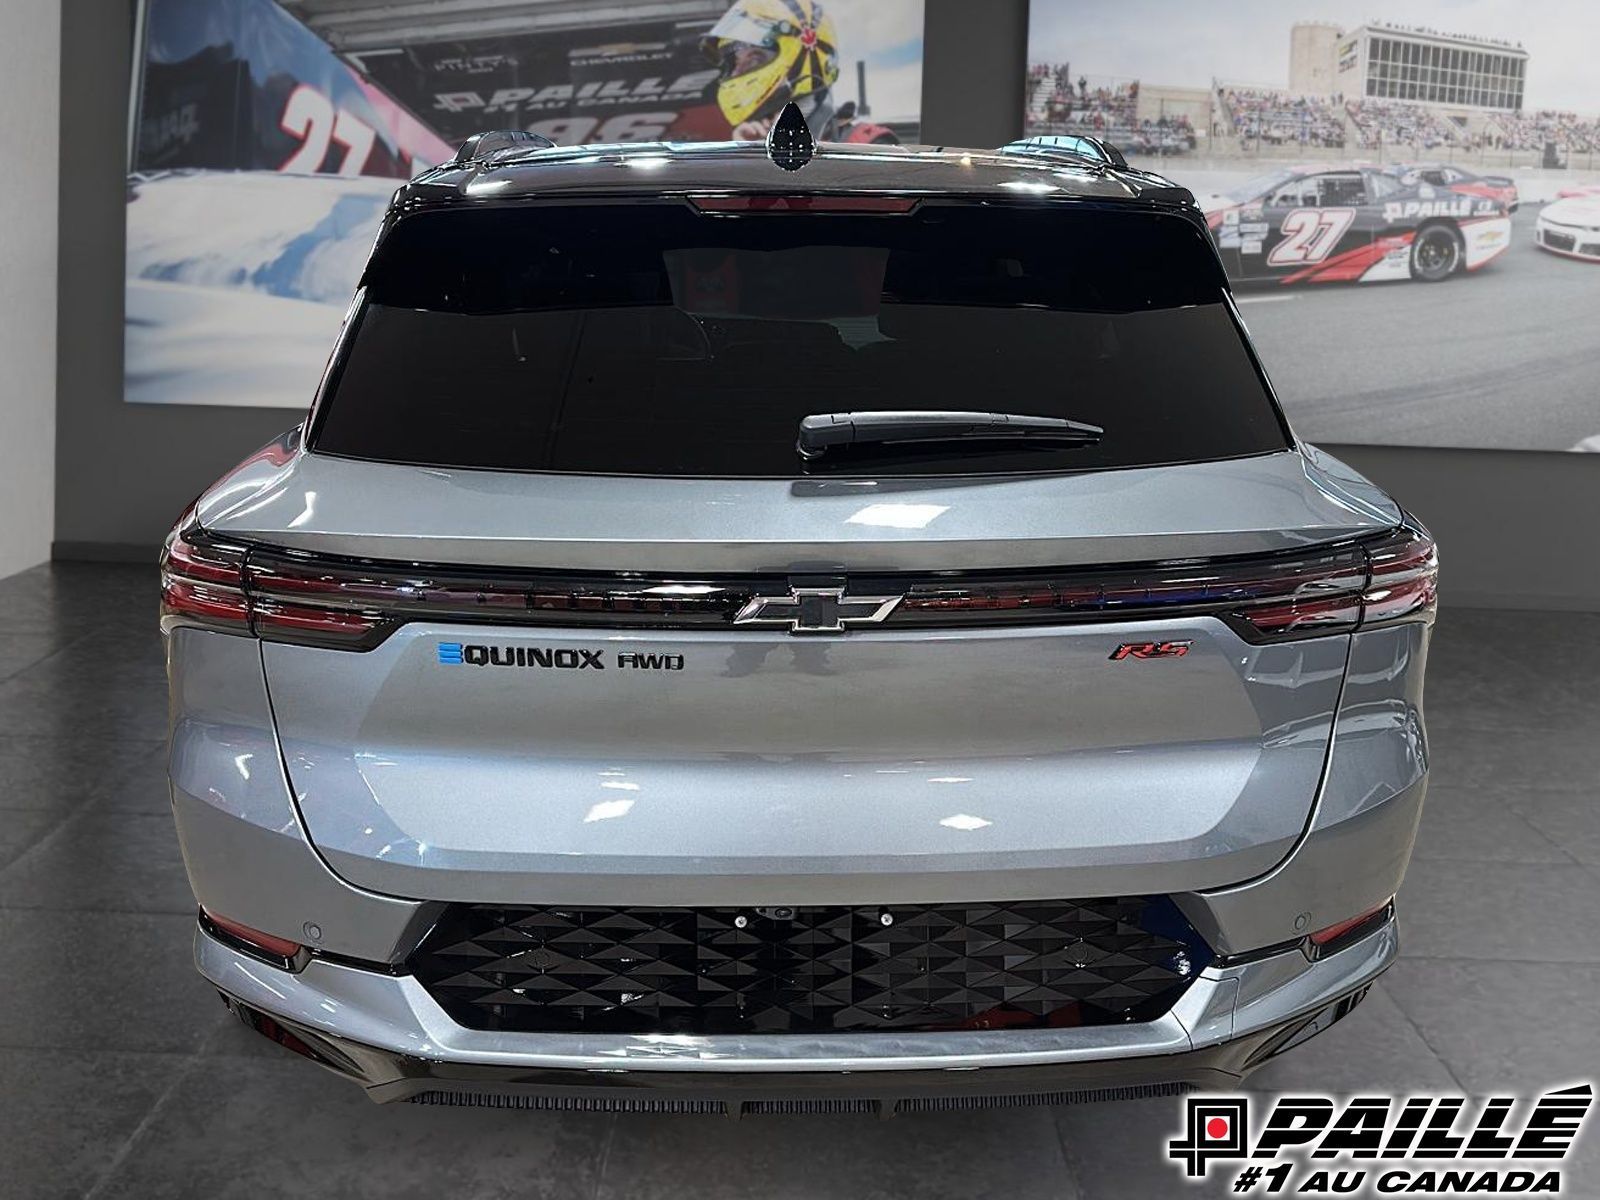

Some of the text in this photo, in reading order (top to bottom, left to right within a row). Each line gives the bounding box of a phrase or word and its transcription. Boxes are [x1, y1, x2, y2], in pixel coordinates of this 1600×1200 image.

[570, 52, 673, 66] CHEVROLET
[577, 91, 703, 107] CANADA
[278, 83, 377, 176] 27
[1266, 206, 1356, 266] 27
[438, 642, 685, 670] EQUINOX AWD
[1108, 639, 1194, 660] RS
